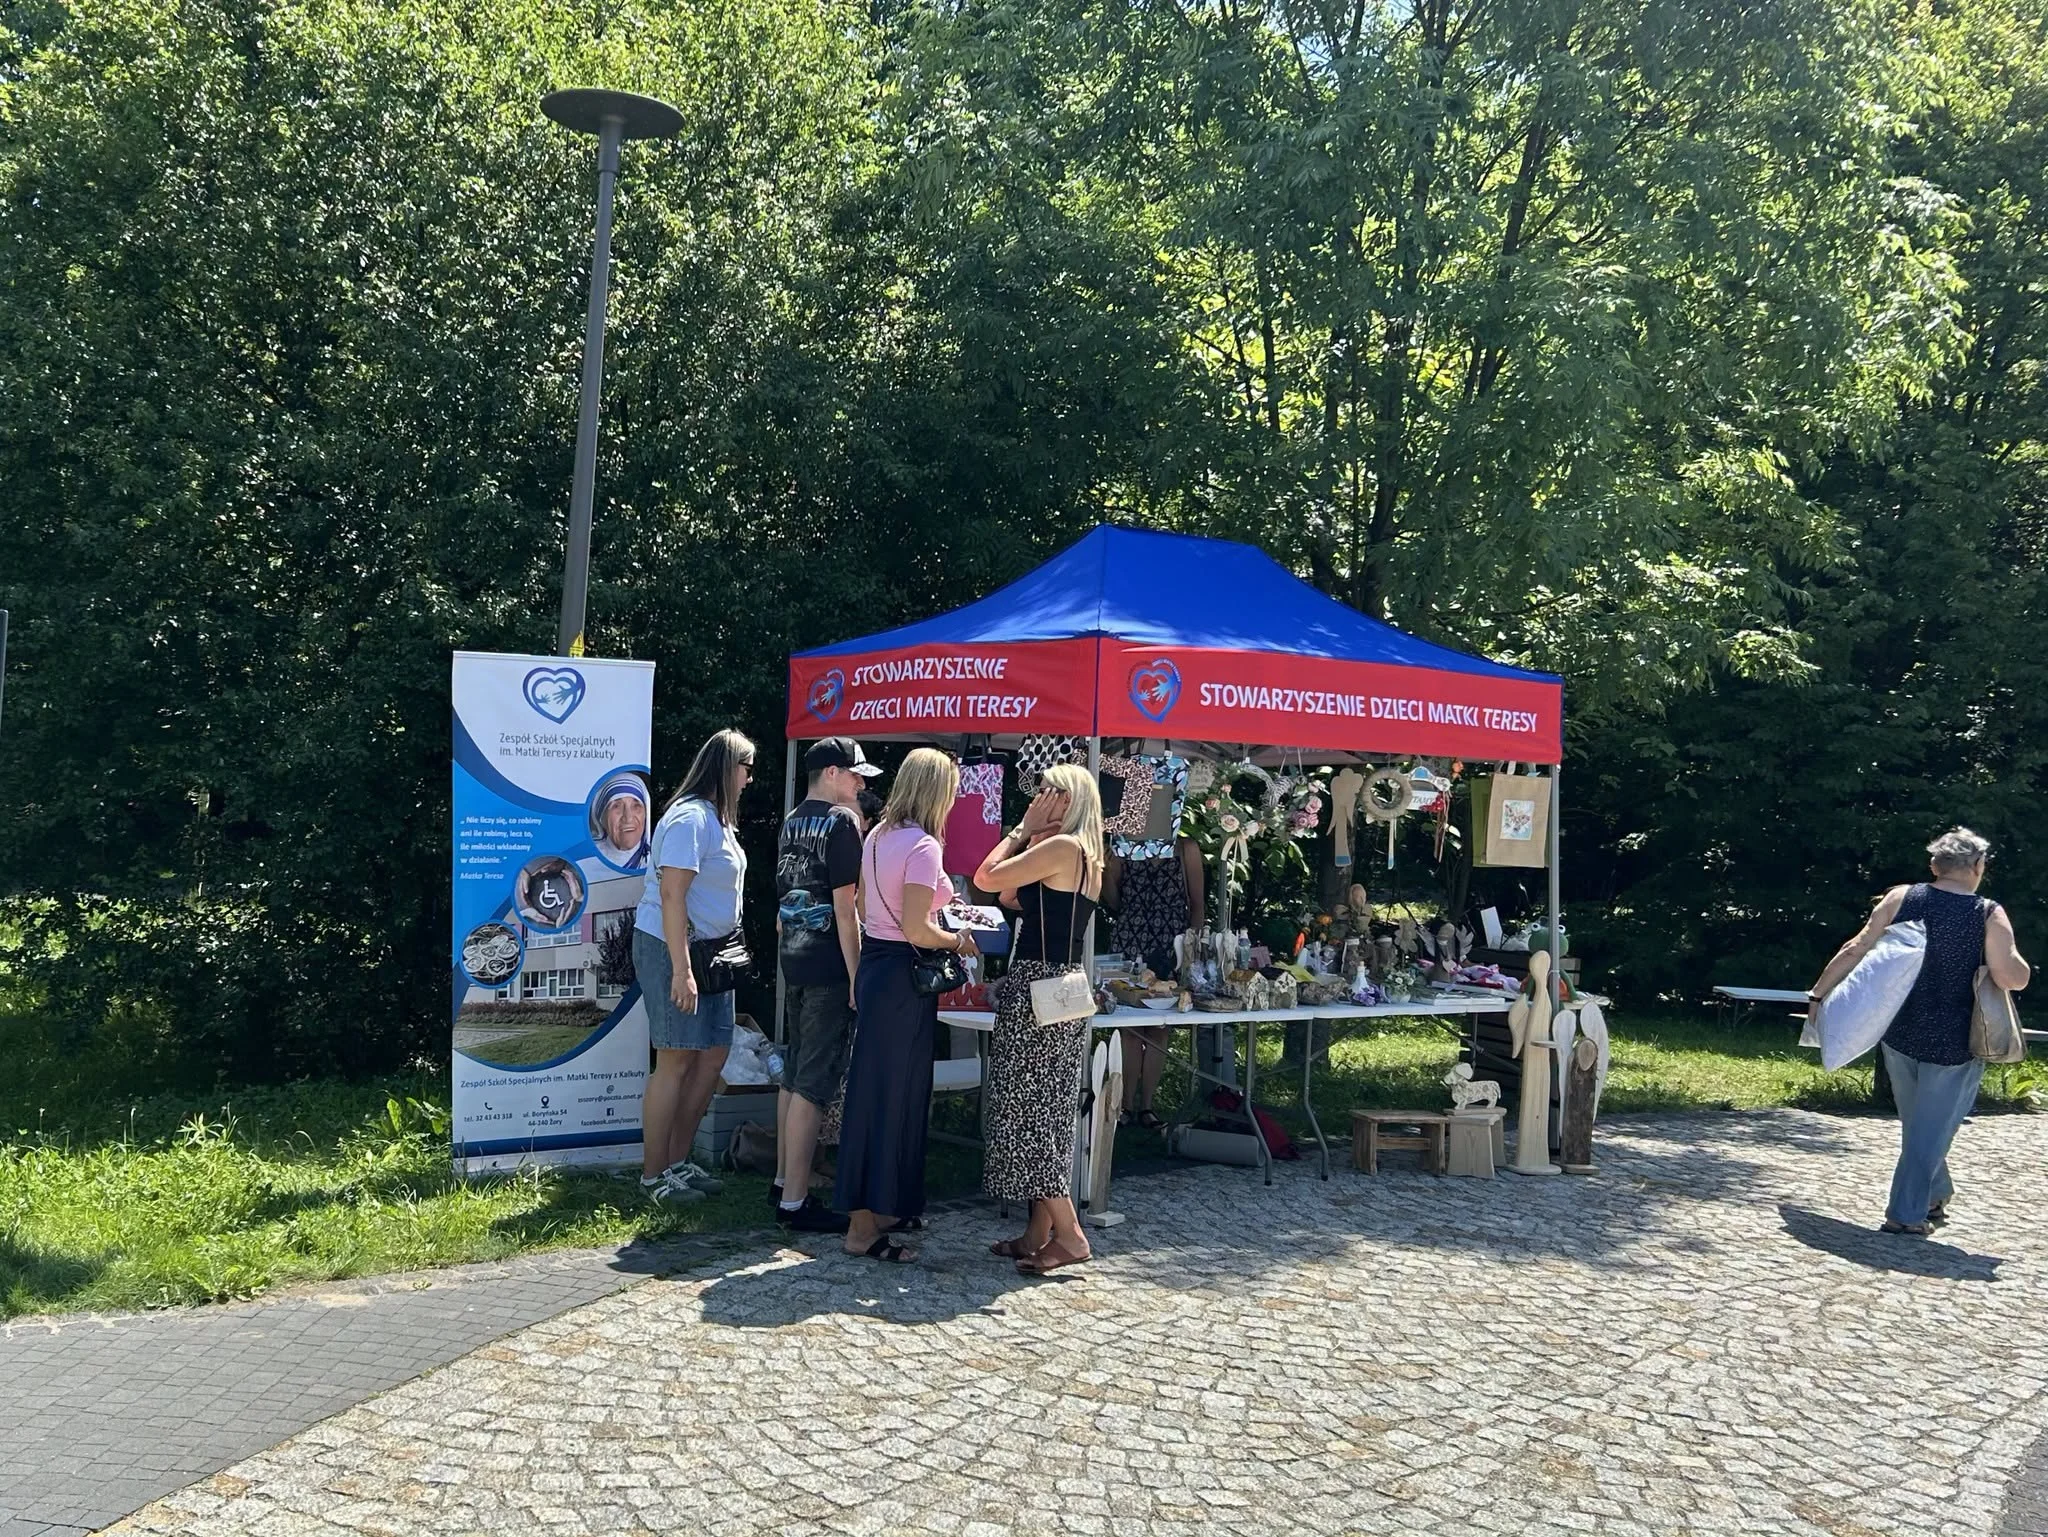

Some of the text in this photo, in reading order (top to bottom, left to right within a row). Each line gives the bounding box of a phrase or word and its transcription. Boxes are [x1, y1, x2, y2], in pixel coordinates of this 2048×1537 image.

[852, 657, 1008, 686] STOWARZYSZENIE
[850, 695, 1038, 721] DZIECI MATKI TERESY
[1200, 682, 1537, 733] STOWARZYSZENIE DZIECI MATKI TERESY
[500, 733, 615, 748] Zespół Szkół Specjalnych
[500, 747, 615, 760] im. Matki Teresy z Kalkuty
[480, 816, 495, 825] liczy
[518, 816, 542, 825] robimy
[461, 1079, 486, 1088] Zespół
[488, 1078, 507, 1086] Szkół
[509, 1075, 551, 1086] Specjalnych
[567, 1072, 588, 1081] Matki
[590, 1072, 612, 1080] Teresy
[619, 1070, 645, 1079] Kalkuty
